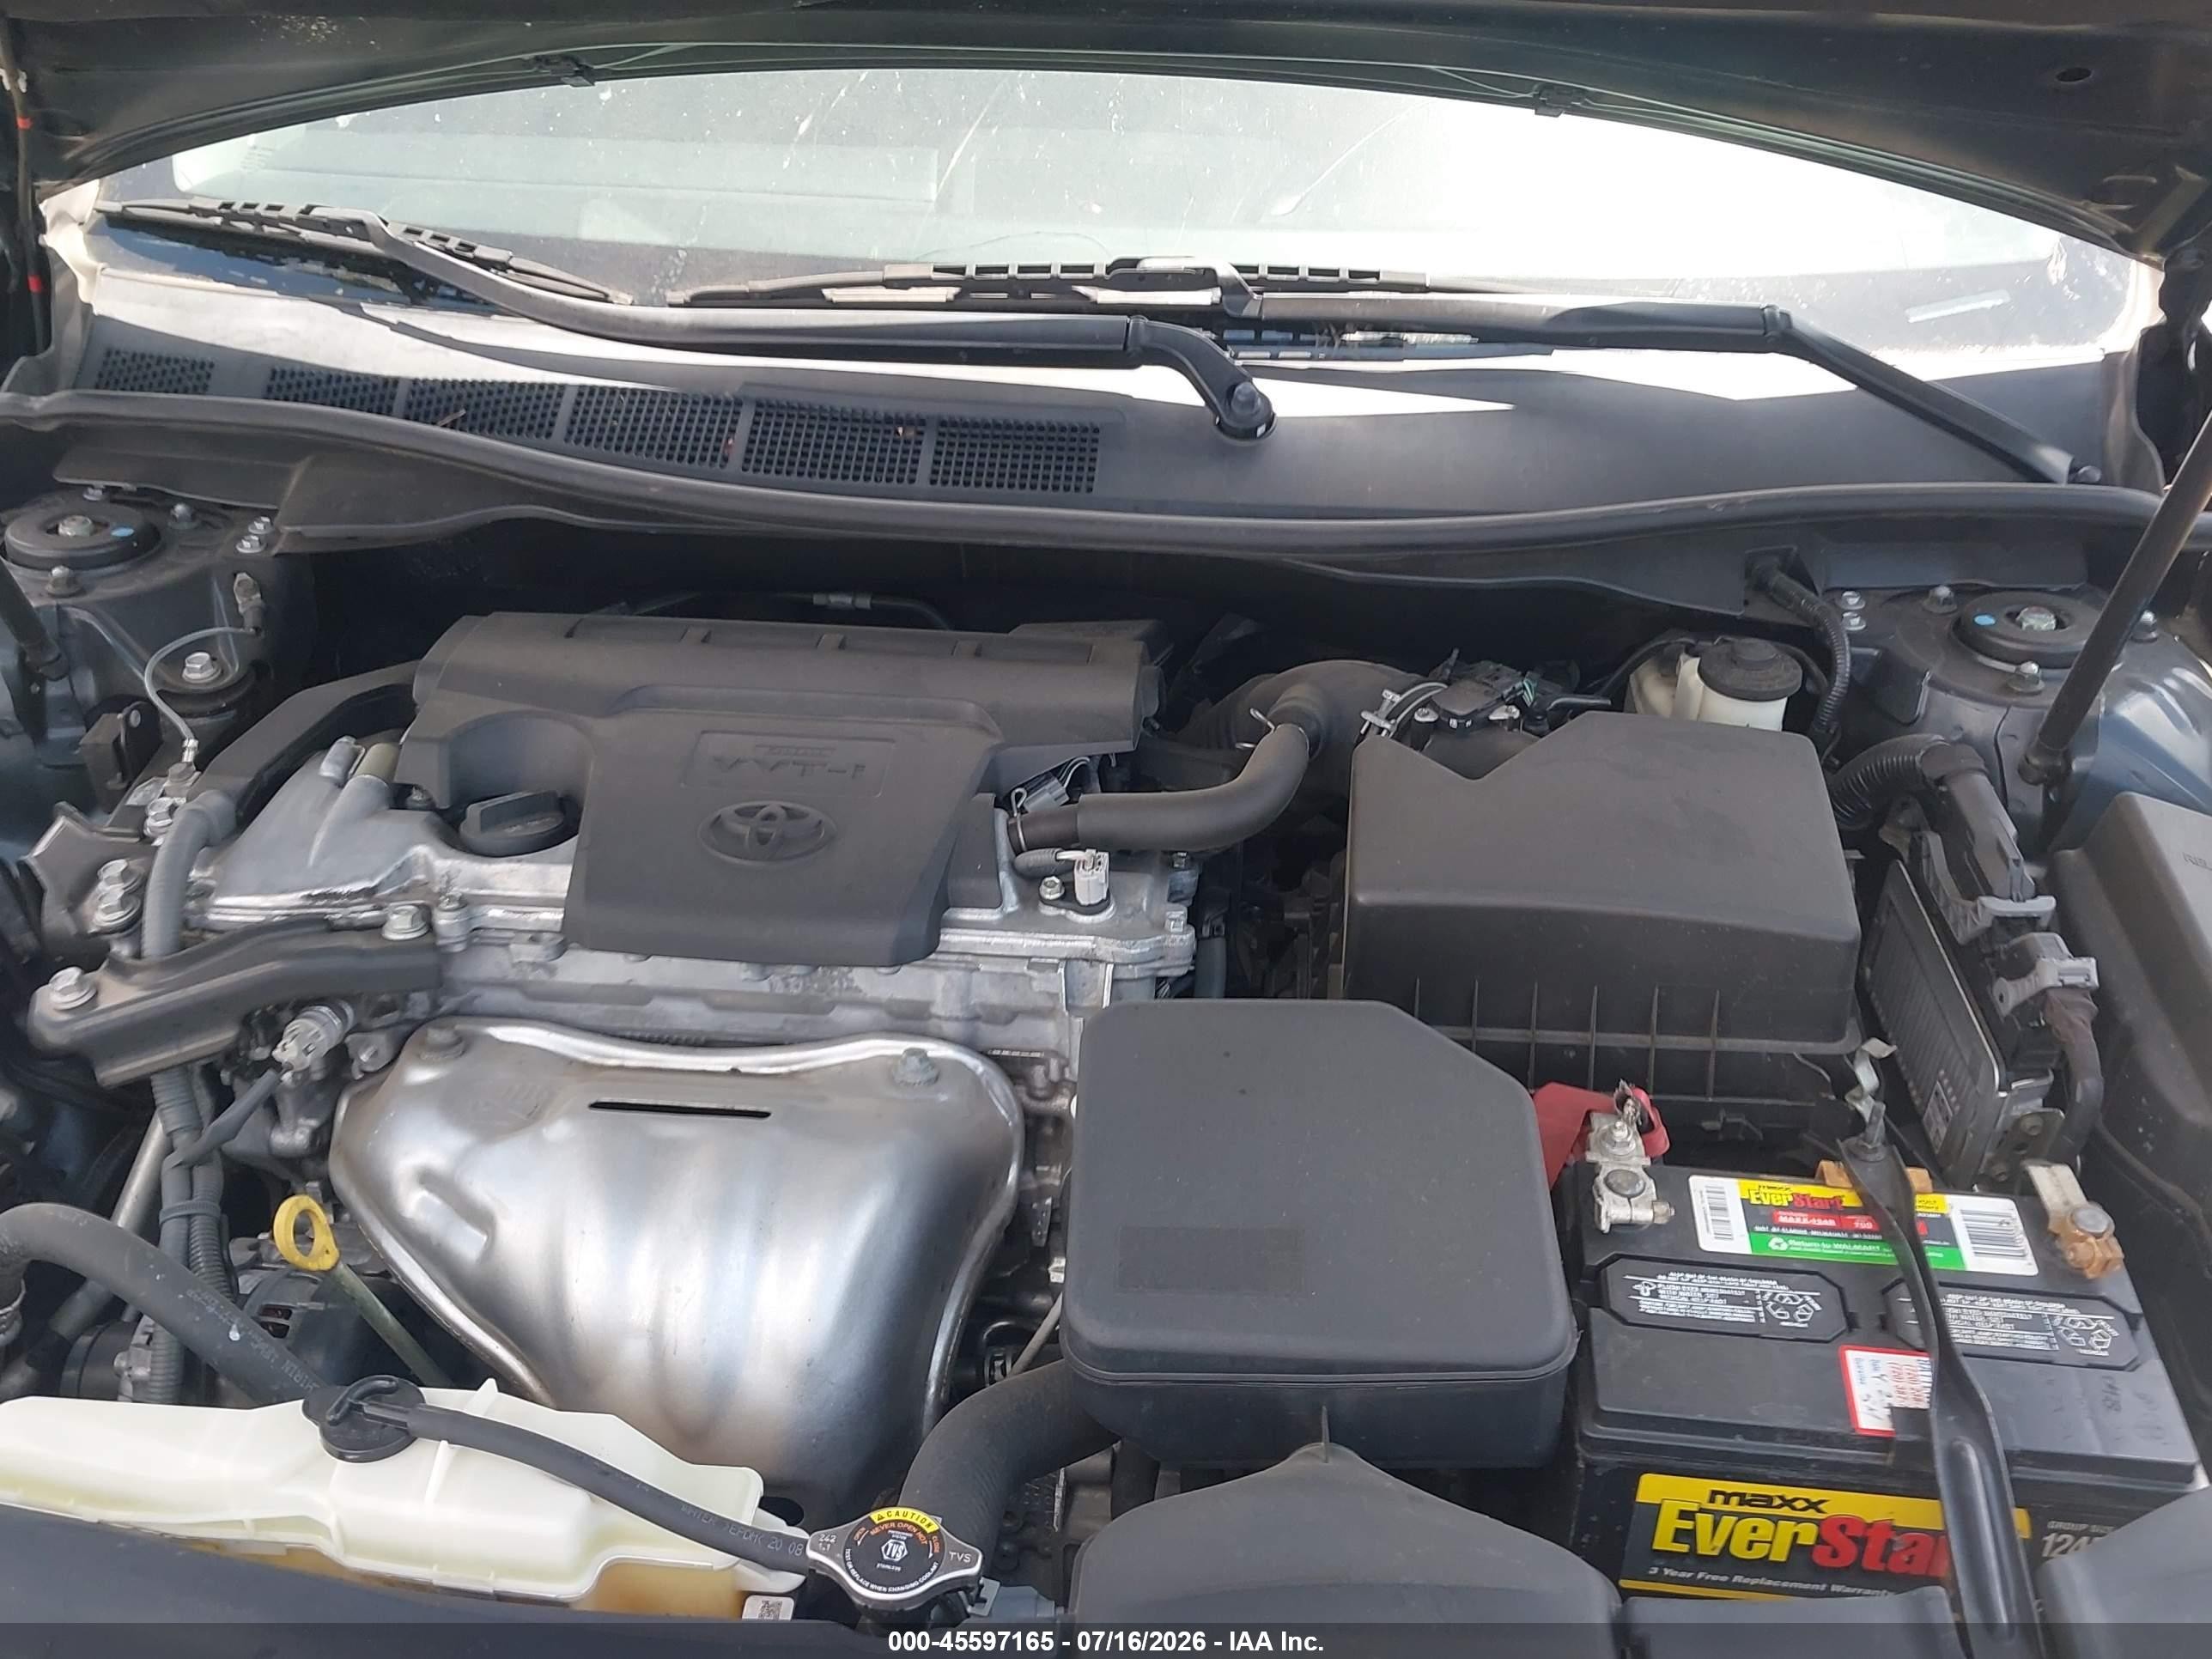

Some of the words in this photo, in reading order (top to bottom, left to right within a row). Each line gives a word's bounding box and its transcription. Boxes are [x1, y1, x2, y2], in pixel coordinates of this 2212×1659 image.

[1748, 1188, 1844, 1211] EverStart
[1709, 1489, 1830, 1514] maxx
[886, 1510, 932, 1528] CAUTION
[2047, 1520, 2088, 1530] GROUP
[870, 1522, 896, 1535] NEVER
[897, 1522, 917, 1533] OPEN
[915, 1528, 928, 1545] HOT
[1652, 1499, 1948, 1577] EverSta
[768, 1536, 783, 1552] 20
[788, 1542, 804, 1556] 08
[886, 1543, 904, 1559] TVS
[949, 1551, 972, 1563] TVS
[2042, 1533, 2102, 1558] 124
[849, 1567, 870, 1588] REPLACE
[869, 1583, 887, 1593] WHEN
[888, 1582, 919, 1593] CHANGING
[919, 1562, 939, 1583] COOLANT
[1648, 1566, 1659, 1575] 3
[1663, 1567, 1694, 1579] Year
[1697, 1571, 1729, 1582] Free
[1732, 1575, 1826, 1591] Replacement
